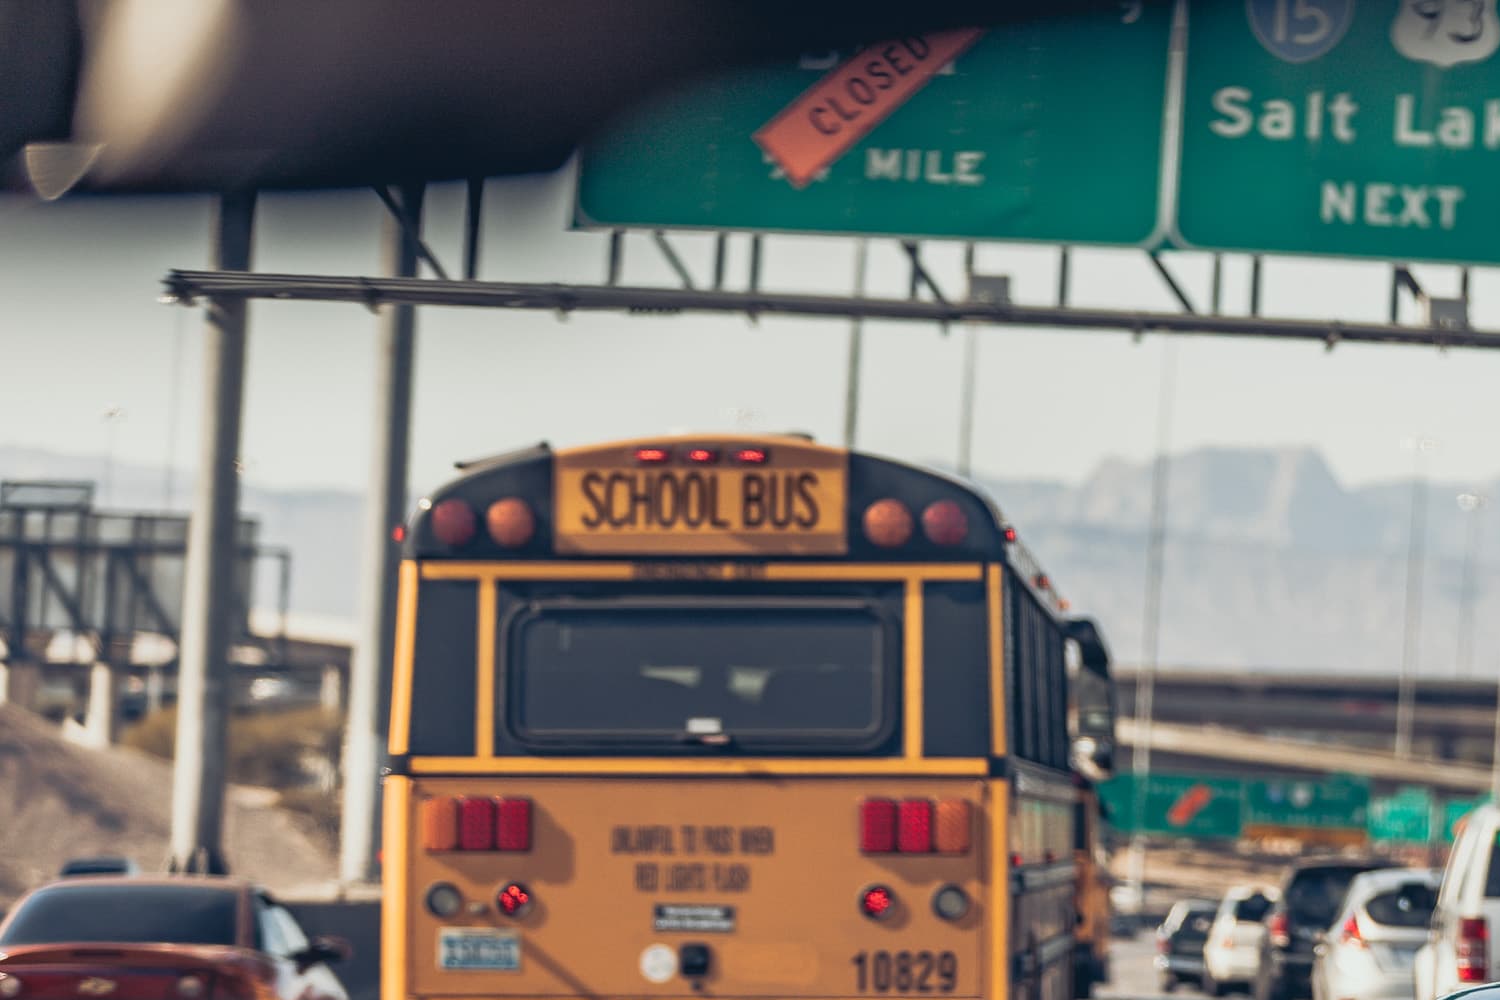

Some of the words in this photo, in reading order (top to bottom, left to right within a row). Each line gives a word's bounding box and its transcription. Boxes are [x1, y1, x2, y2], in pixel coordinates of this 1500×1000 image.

[1274, 0, 1332, 44] 15
[808, 33, 931, 137] CLOSED
[1209, 86, 1359, 142] Salt
[864, 147, 987, 185] MILE
[1321, 181, 1465, 229] NEXT
[581, 471, 730, 530] SCHOOL
[743, 471, 821, 530] BUS
[850, 950, 958, 993] 10829
